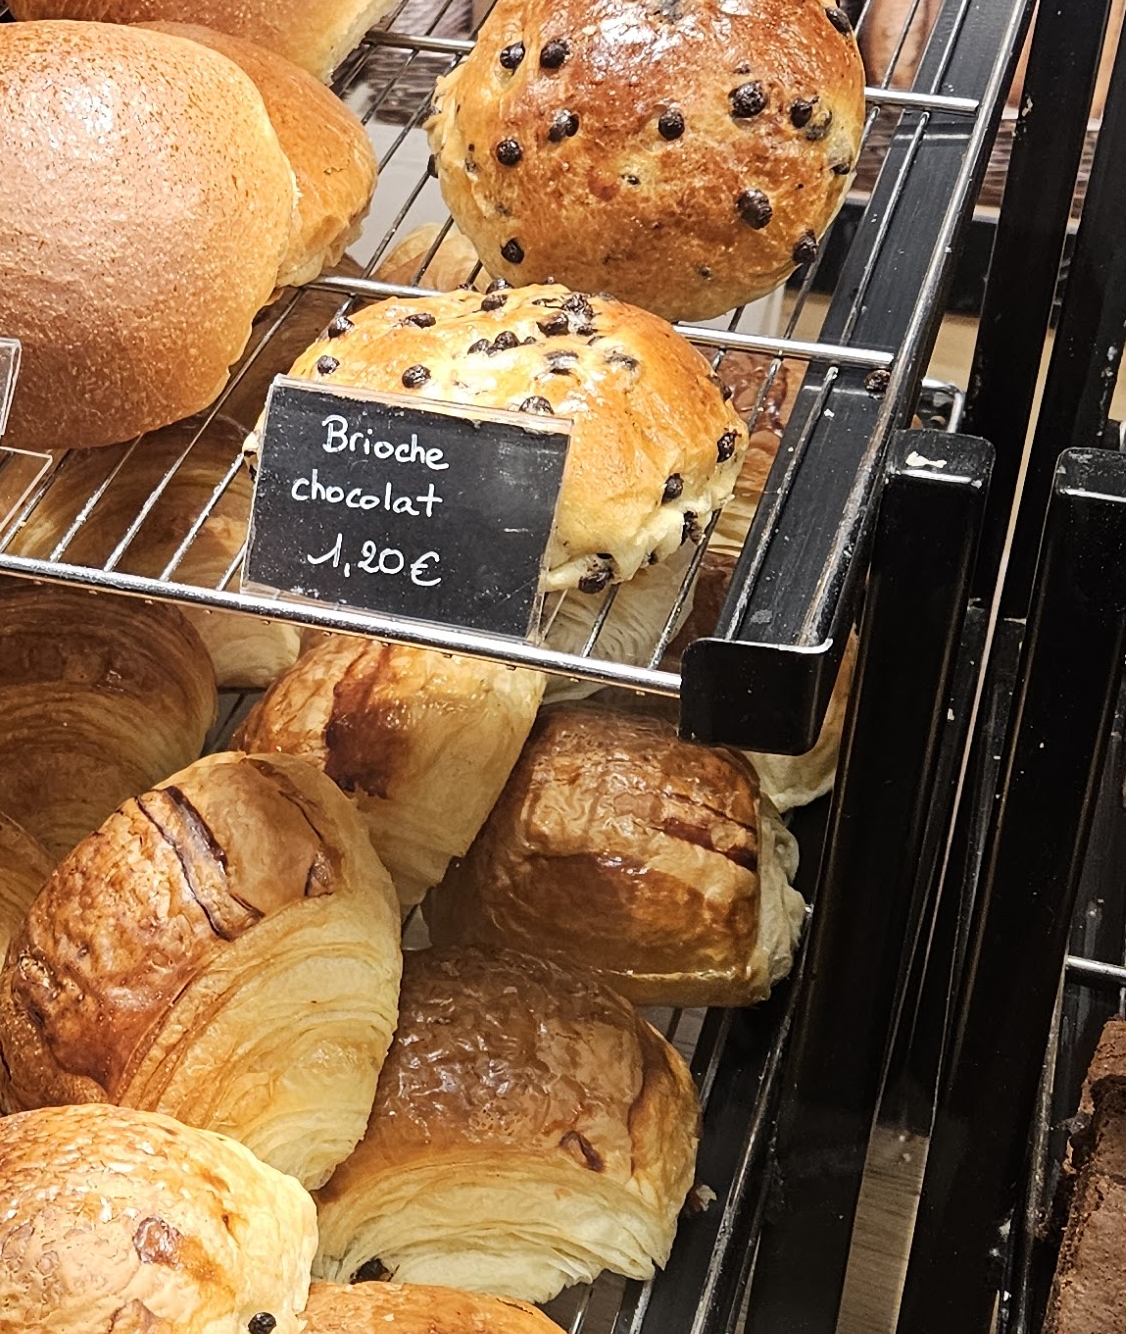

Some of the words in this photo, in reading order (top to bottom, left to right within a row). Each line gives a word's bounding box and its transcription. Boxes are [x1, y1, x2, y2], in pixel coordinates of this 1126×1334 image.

[321, 413, 450, 471] Brioche
[290, 468, 443, 518] chocolat
[307, 532, 442, 587] 1,20€
